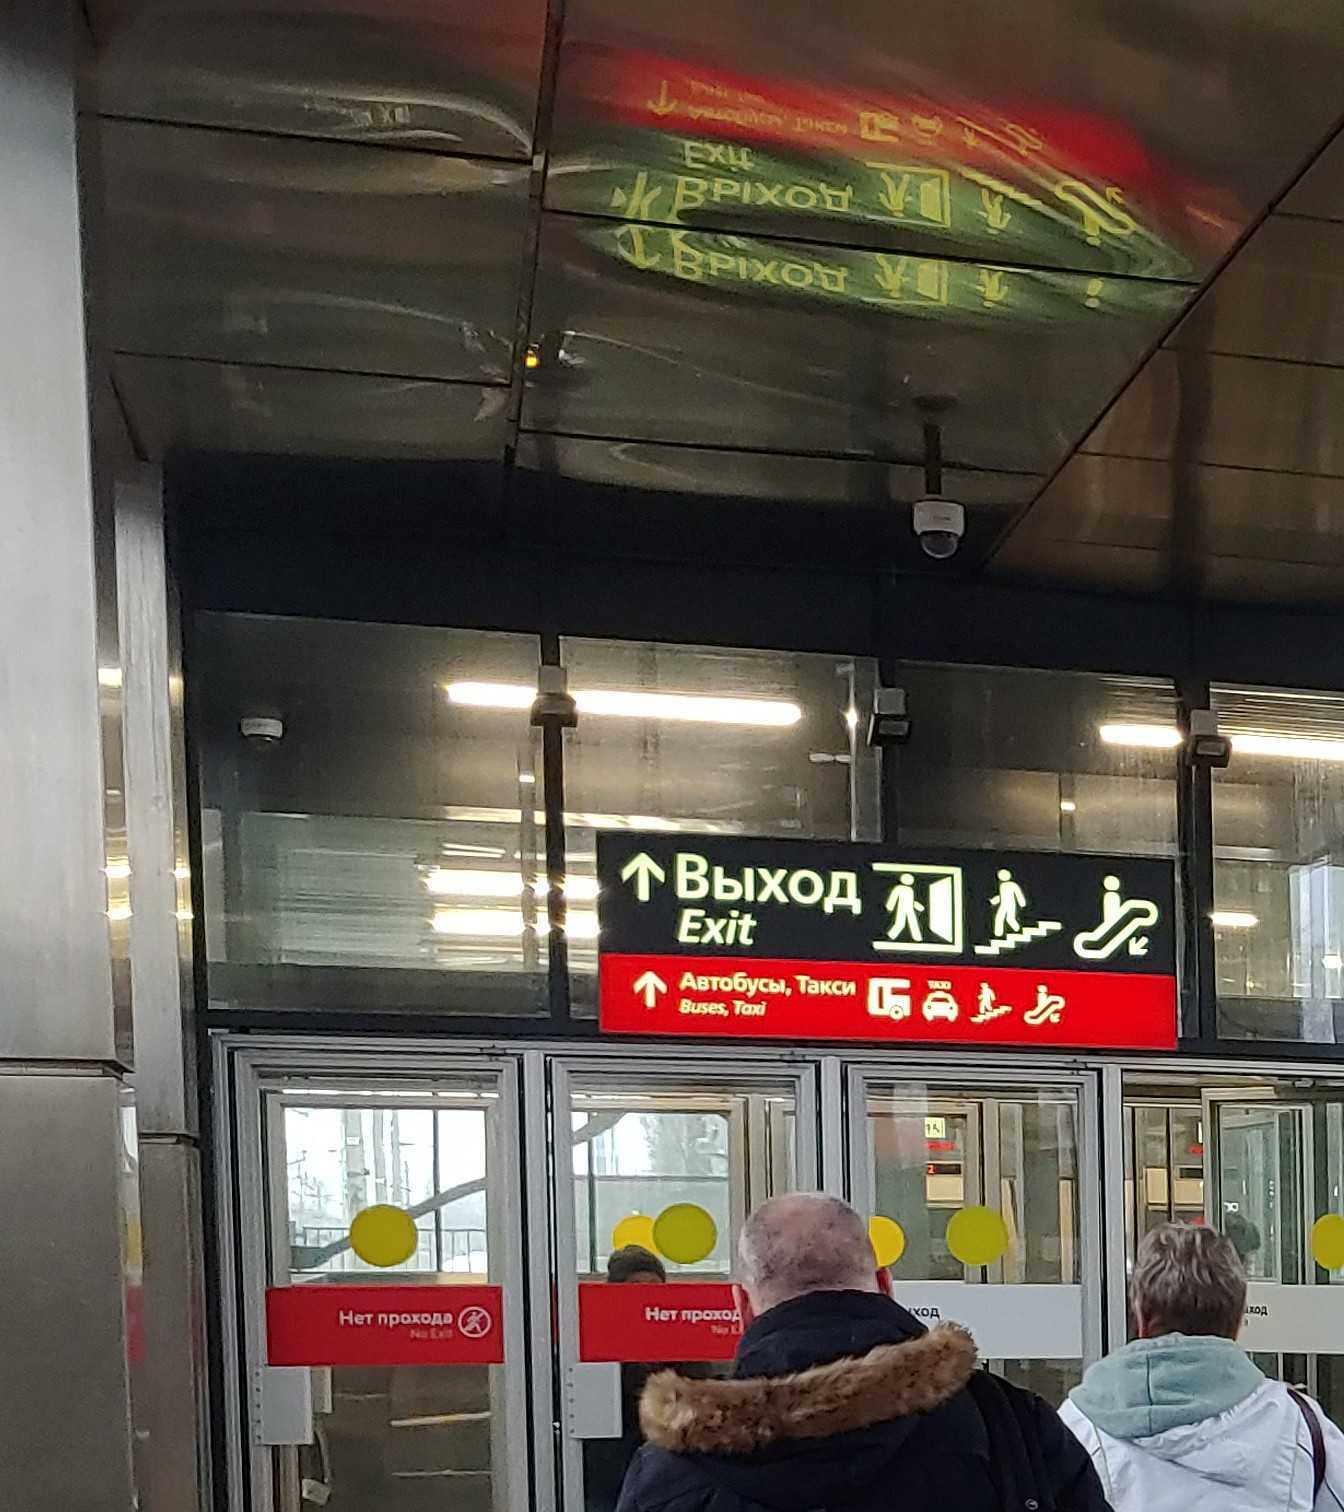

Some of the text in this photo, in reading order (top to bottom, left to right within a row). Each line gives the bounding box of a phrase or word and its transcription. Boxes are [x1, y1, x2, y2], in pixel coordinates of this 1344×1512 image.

[676, 853, 862, 915] Выход
[677, 908, 757, 946] Exit
[679, 971, 857, 997] Автобусы, Такси
[678, 998, 767, 1016] Buses, Taxi
[339, 1309, 454, 1329] Нет прохода
[645, 1306, 741, 1324] Нет проход
[908, 1306, 940, 1321] ход
